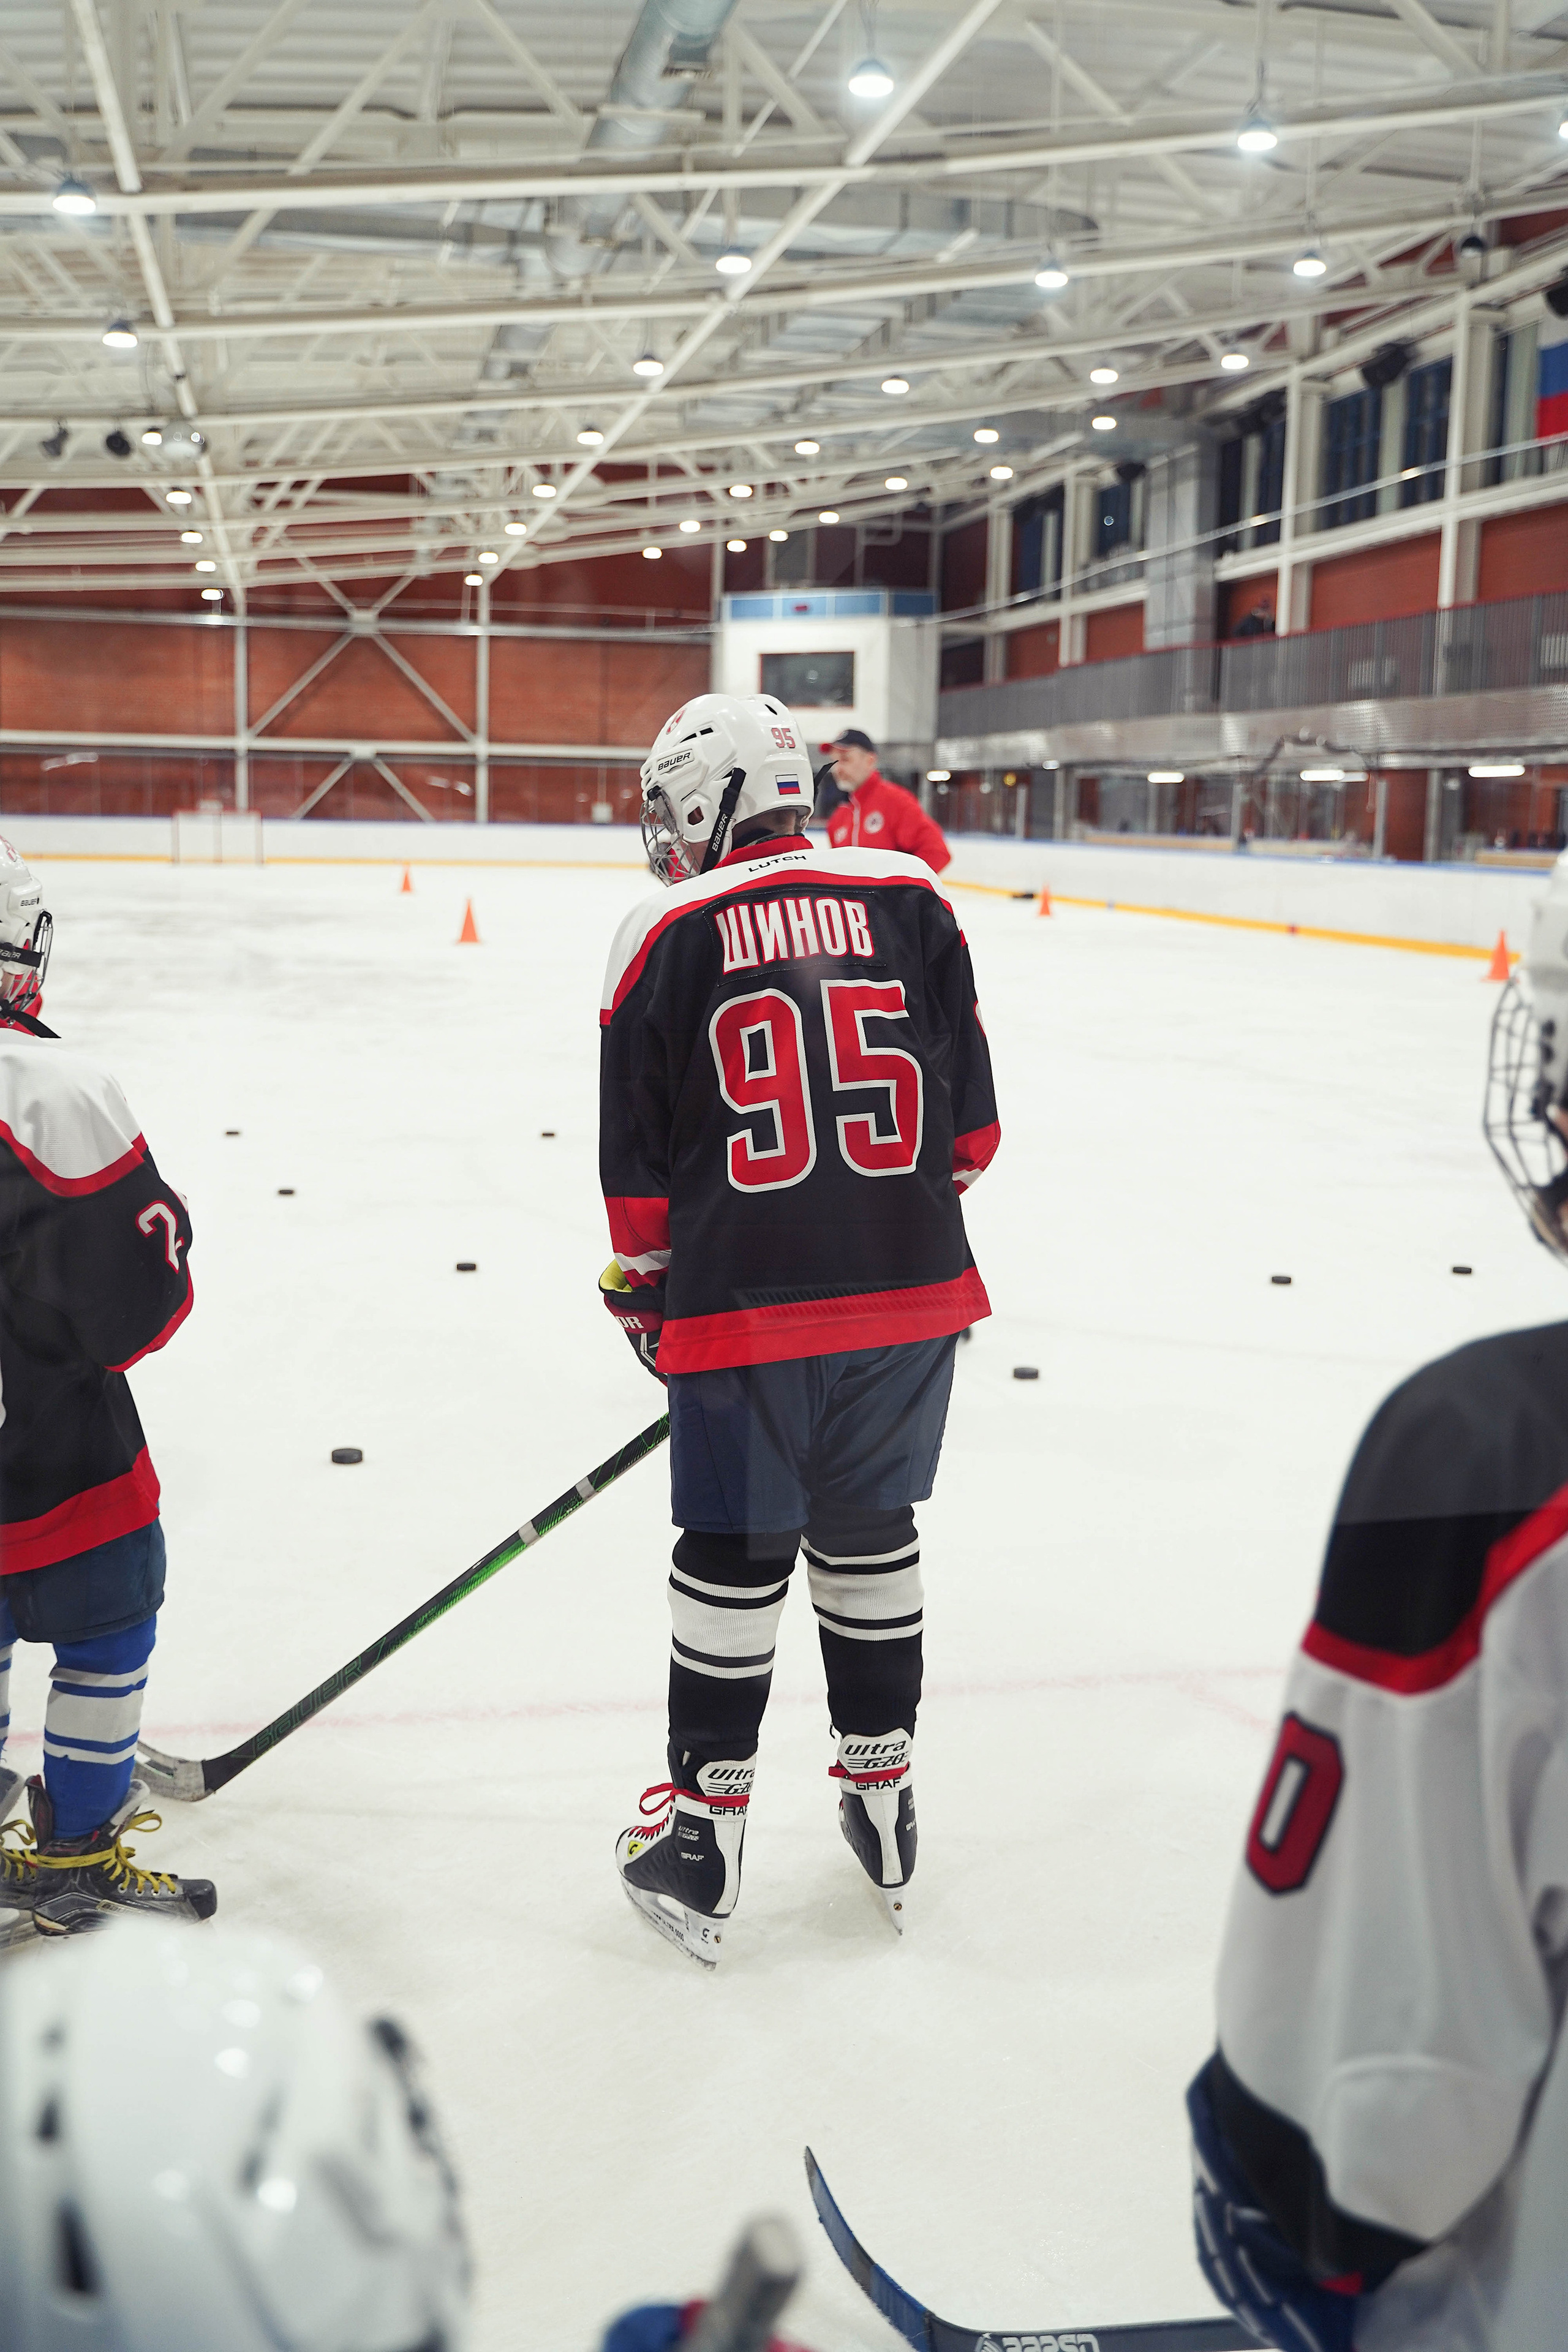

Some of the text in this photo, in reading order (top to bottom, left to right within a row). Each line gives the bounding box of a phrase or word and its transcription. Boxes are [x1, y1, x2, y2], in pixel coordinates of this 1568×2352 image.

[771, 728, 796, 748] 95
[658, 752, 690, 771] BAUER
[712, 813, 728, 852] BAUER
[748, 856, 807, 872] LUTCH
[715, 897, 875, 975] ШИНОВ
[709, 979, 922, 1193] 95
[680, 1852, 704, 1861] GRAF
